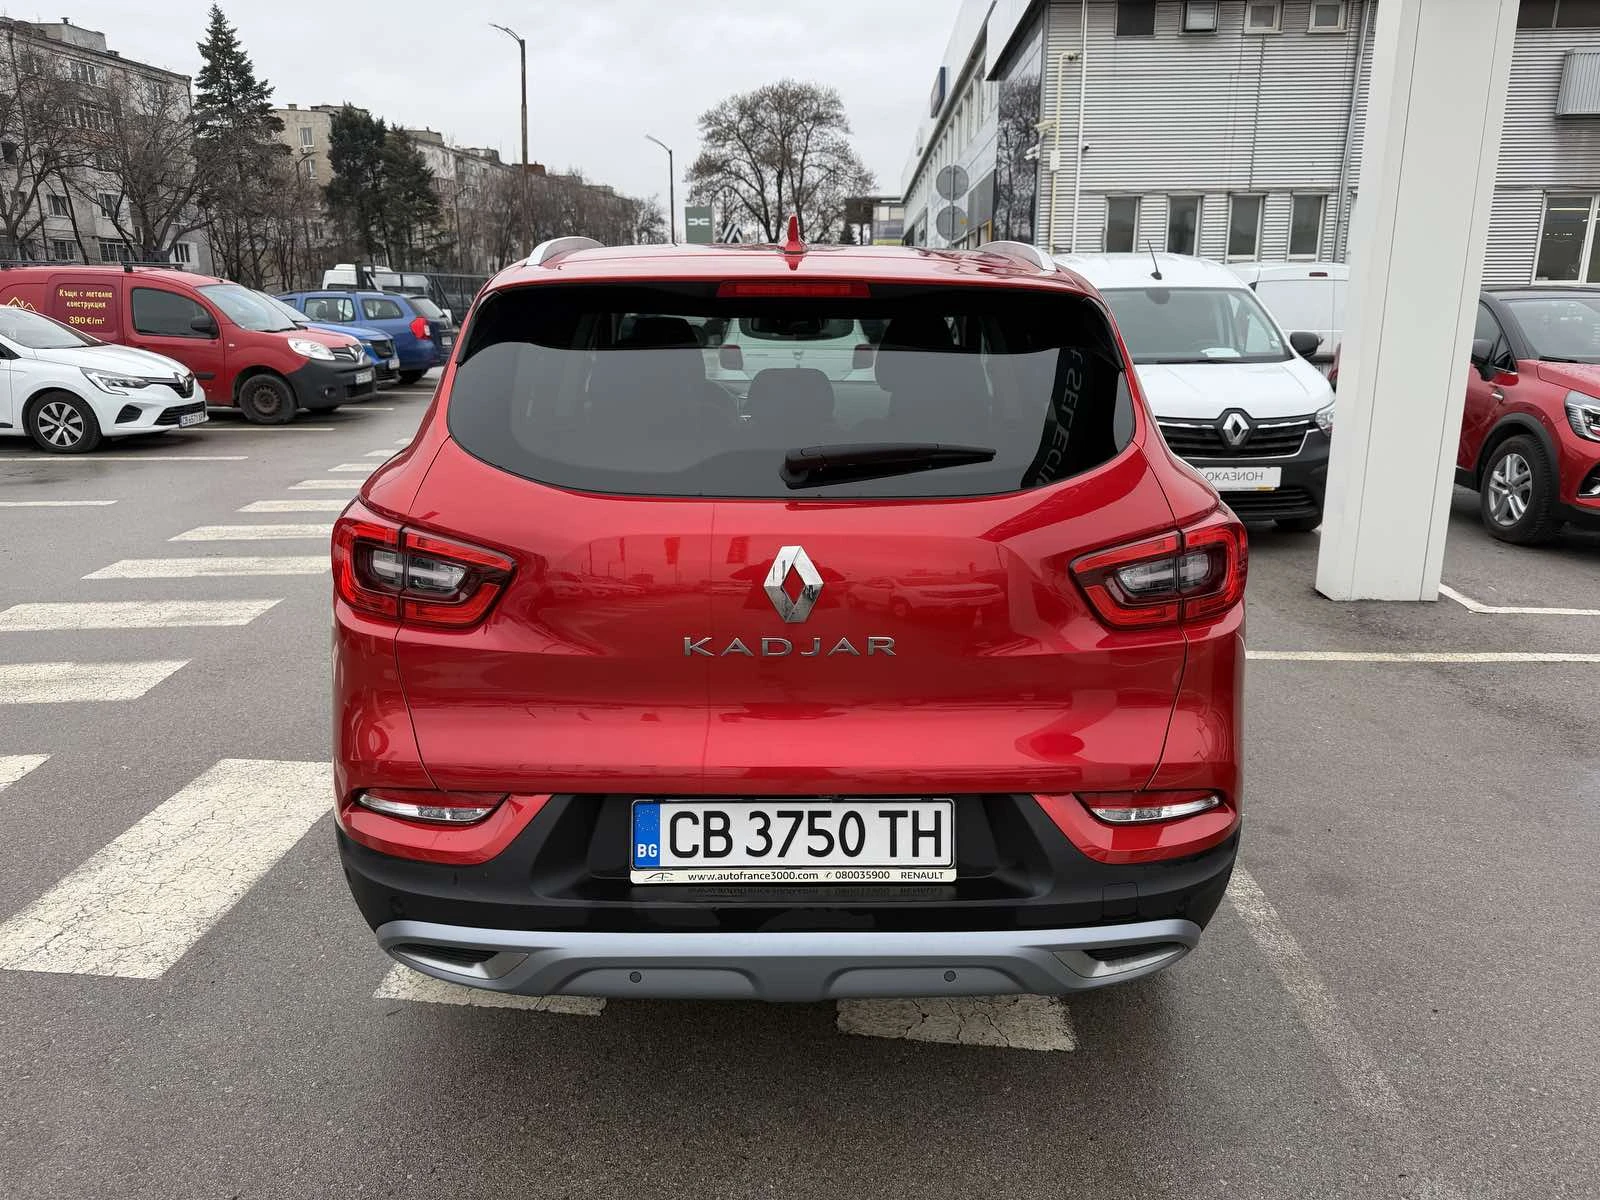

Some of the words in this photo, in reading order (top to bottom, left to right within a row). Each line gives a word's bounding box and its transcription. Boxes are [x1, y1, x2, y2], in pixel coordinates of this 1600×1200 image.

[1206, 472, 1264, 481] ОКАЗИОН
[683, 636, 897, 657] KADJAR
[669, 810, 733, 858] CB
[745, 810, 866, 858] 3750
[878, 810, 942, 858] TH
[637, 844, 657, 858] BG
[688, 871, 819, 881] www.autofrance3000.com
[835, 871, 890, 879] 080035900
[900, 871, 944, 879] RENAULT
